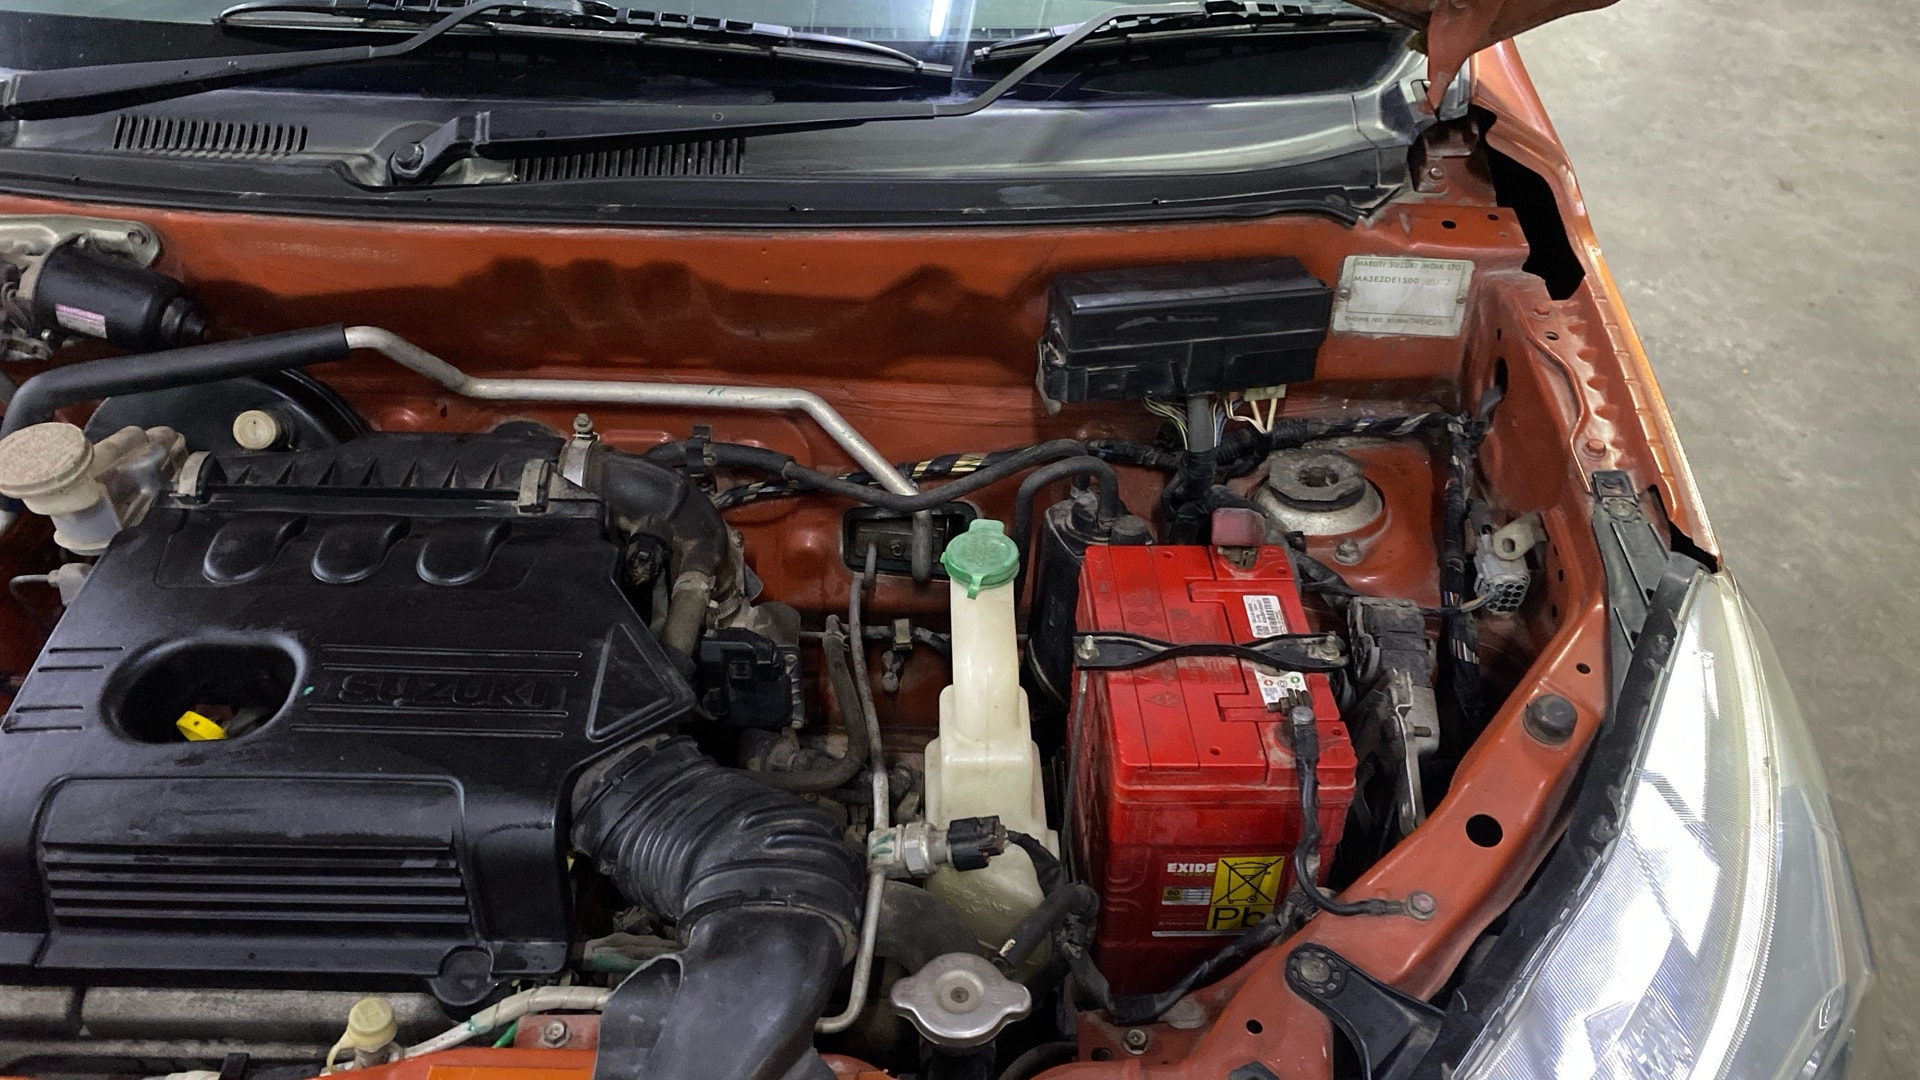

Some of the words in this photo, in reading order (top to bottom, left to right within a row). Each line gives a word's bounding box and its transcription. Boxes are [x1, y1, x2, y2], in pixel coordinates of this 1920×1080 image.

[1355, 261, 1386, 269] MARUTI
[337, 674, 549, 708] SUZUKI
[1167, 862, 1217, 873] EXIDE
[1211, 907, 1266, 930] Pb
